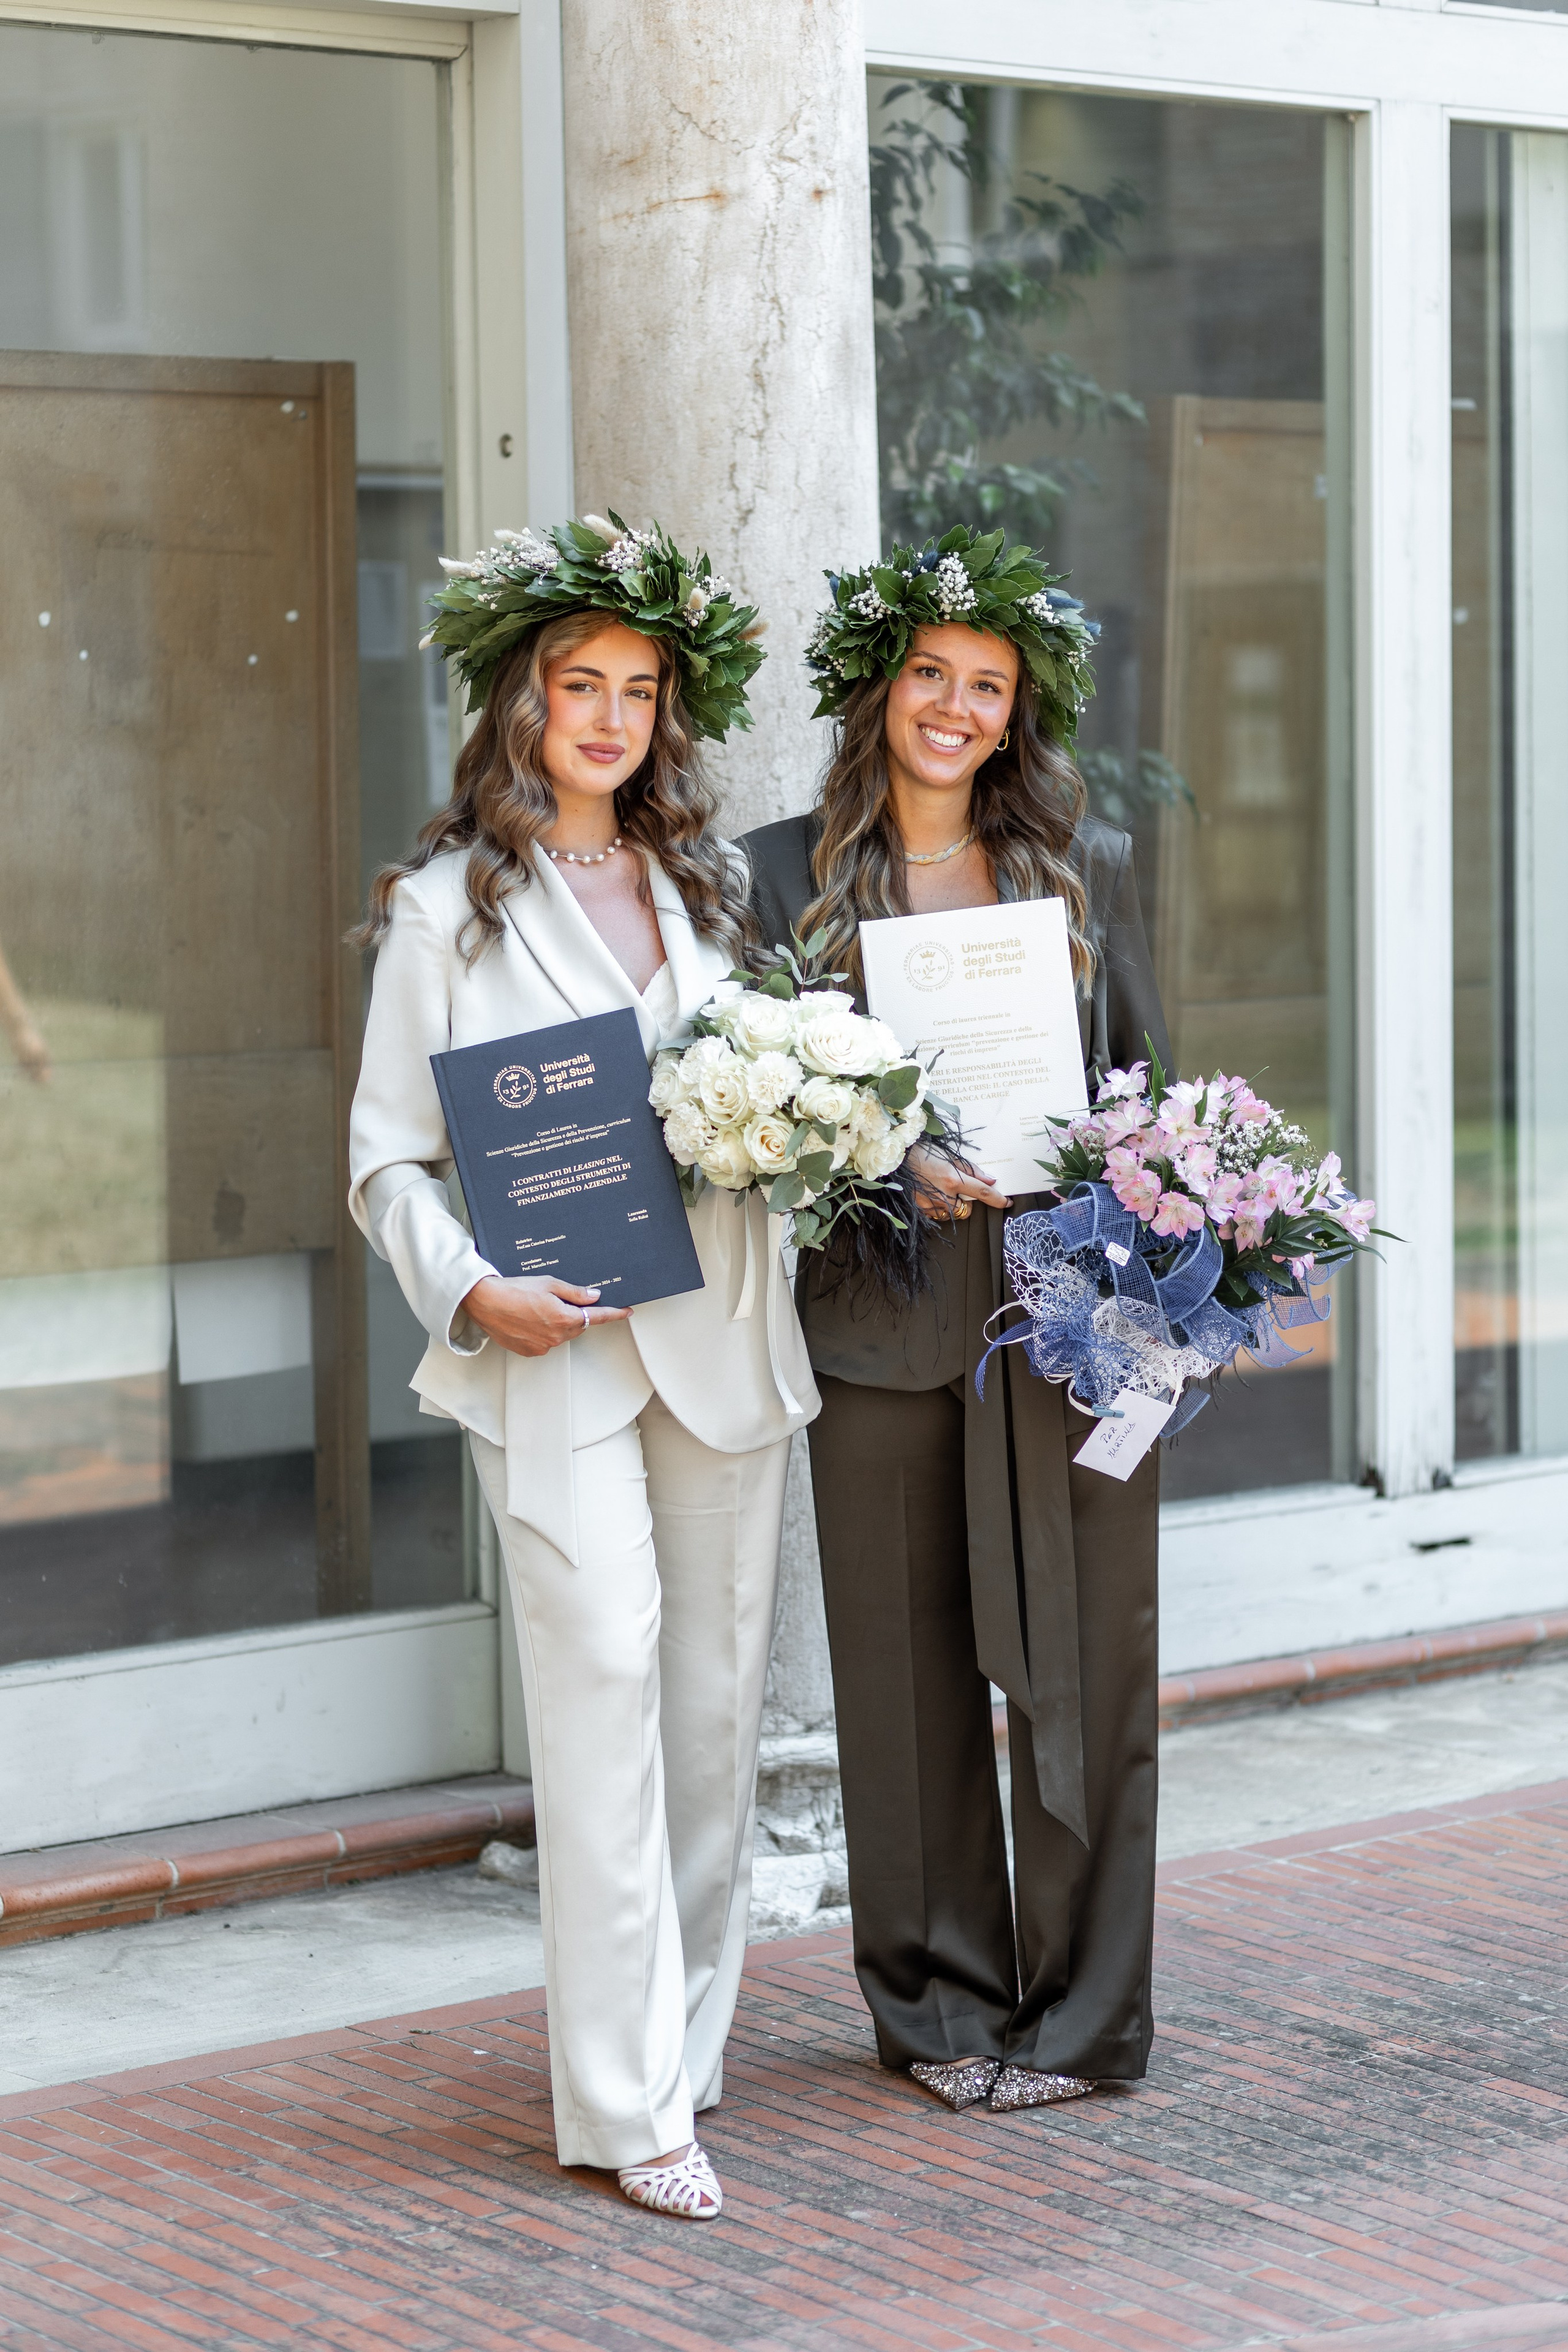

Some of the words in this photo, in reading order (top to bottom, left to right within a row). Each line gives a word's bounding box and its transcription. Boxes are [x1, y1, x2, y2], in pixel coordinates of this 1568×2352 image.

[961, 937, 1021, 954] Università
[963, 954, 992, 967] degli
[995, 950, 1026, 963] Studi
[965, 970, 975, 980] di
[978, 966, 1022, 978] Ferrara
[938, 1033, 968, 1042] Giuridiche
[985, 1028, 1012, 1036] Sicurezza
[938, 1041, 970, 1050] curriculum
[1016, 1033, 1039, 1041] gestione
[540, 1053, 590, 1072] Università
[952, 1060, 1016, 1074] RESPONSABILITÀ
[1018, 1057, 1041, 1066] DEGLI
[543, 1069, 568, 1084] degli
[568, 1063, 595, 1077] Studi
[993, 1068, 1034, 1079] CONTESTO
[546, 1084, 556, 1095] di
[556, 1077, 594, 1092] Ferrara
[942, 1086, 967, 1095] DELLA
[968, 1083, 991, 1091] CRISI:
[1025, 1076, 1049, 1085] DELLA
[953, 1095, 978, 1103] BANCA
[981, 1091, 1009, 1099] CARIGE
[504, 1143, 529, 1153] Giuridiche
[540, 1135, 562, 1144] Sicurezza
[577, 1125, 607, 1135] Prevenzione,
[606, 1118, 631, 1128] curriculum
[545, 1142, 564, 1151] gestione
[517, 1169, 562, 1186] CONTRATTI
[562, 1166, 573, 1175] DI
[573, 1158, 606, 1172] LEASING
[606, 1155, 623, 1164] NEL
[508, 1183, 550, 1198] CONTESTO
[550, 1176, 576, 1188] DEGLI
[575, 1164, 622, 1182] STRUMENTI
[516, 1185, 582, 1207] FINANZIAMENTO
[583, 1173, 628, 1190] AZIENDALE
[1100, 1427, 1117, 1444] PER
